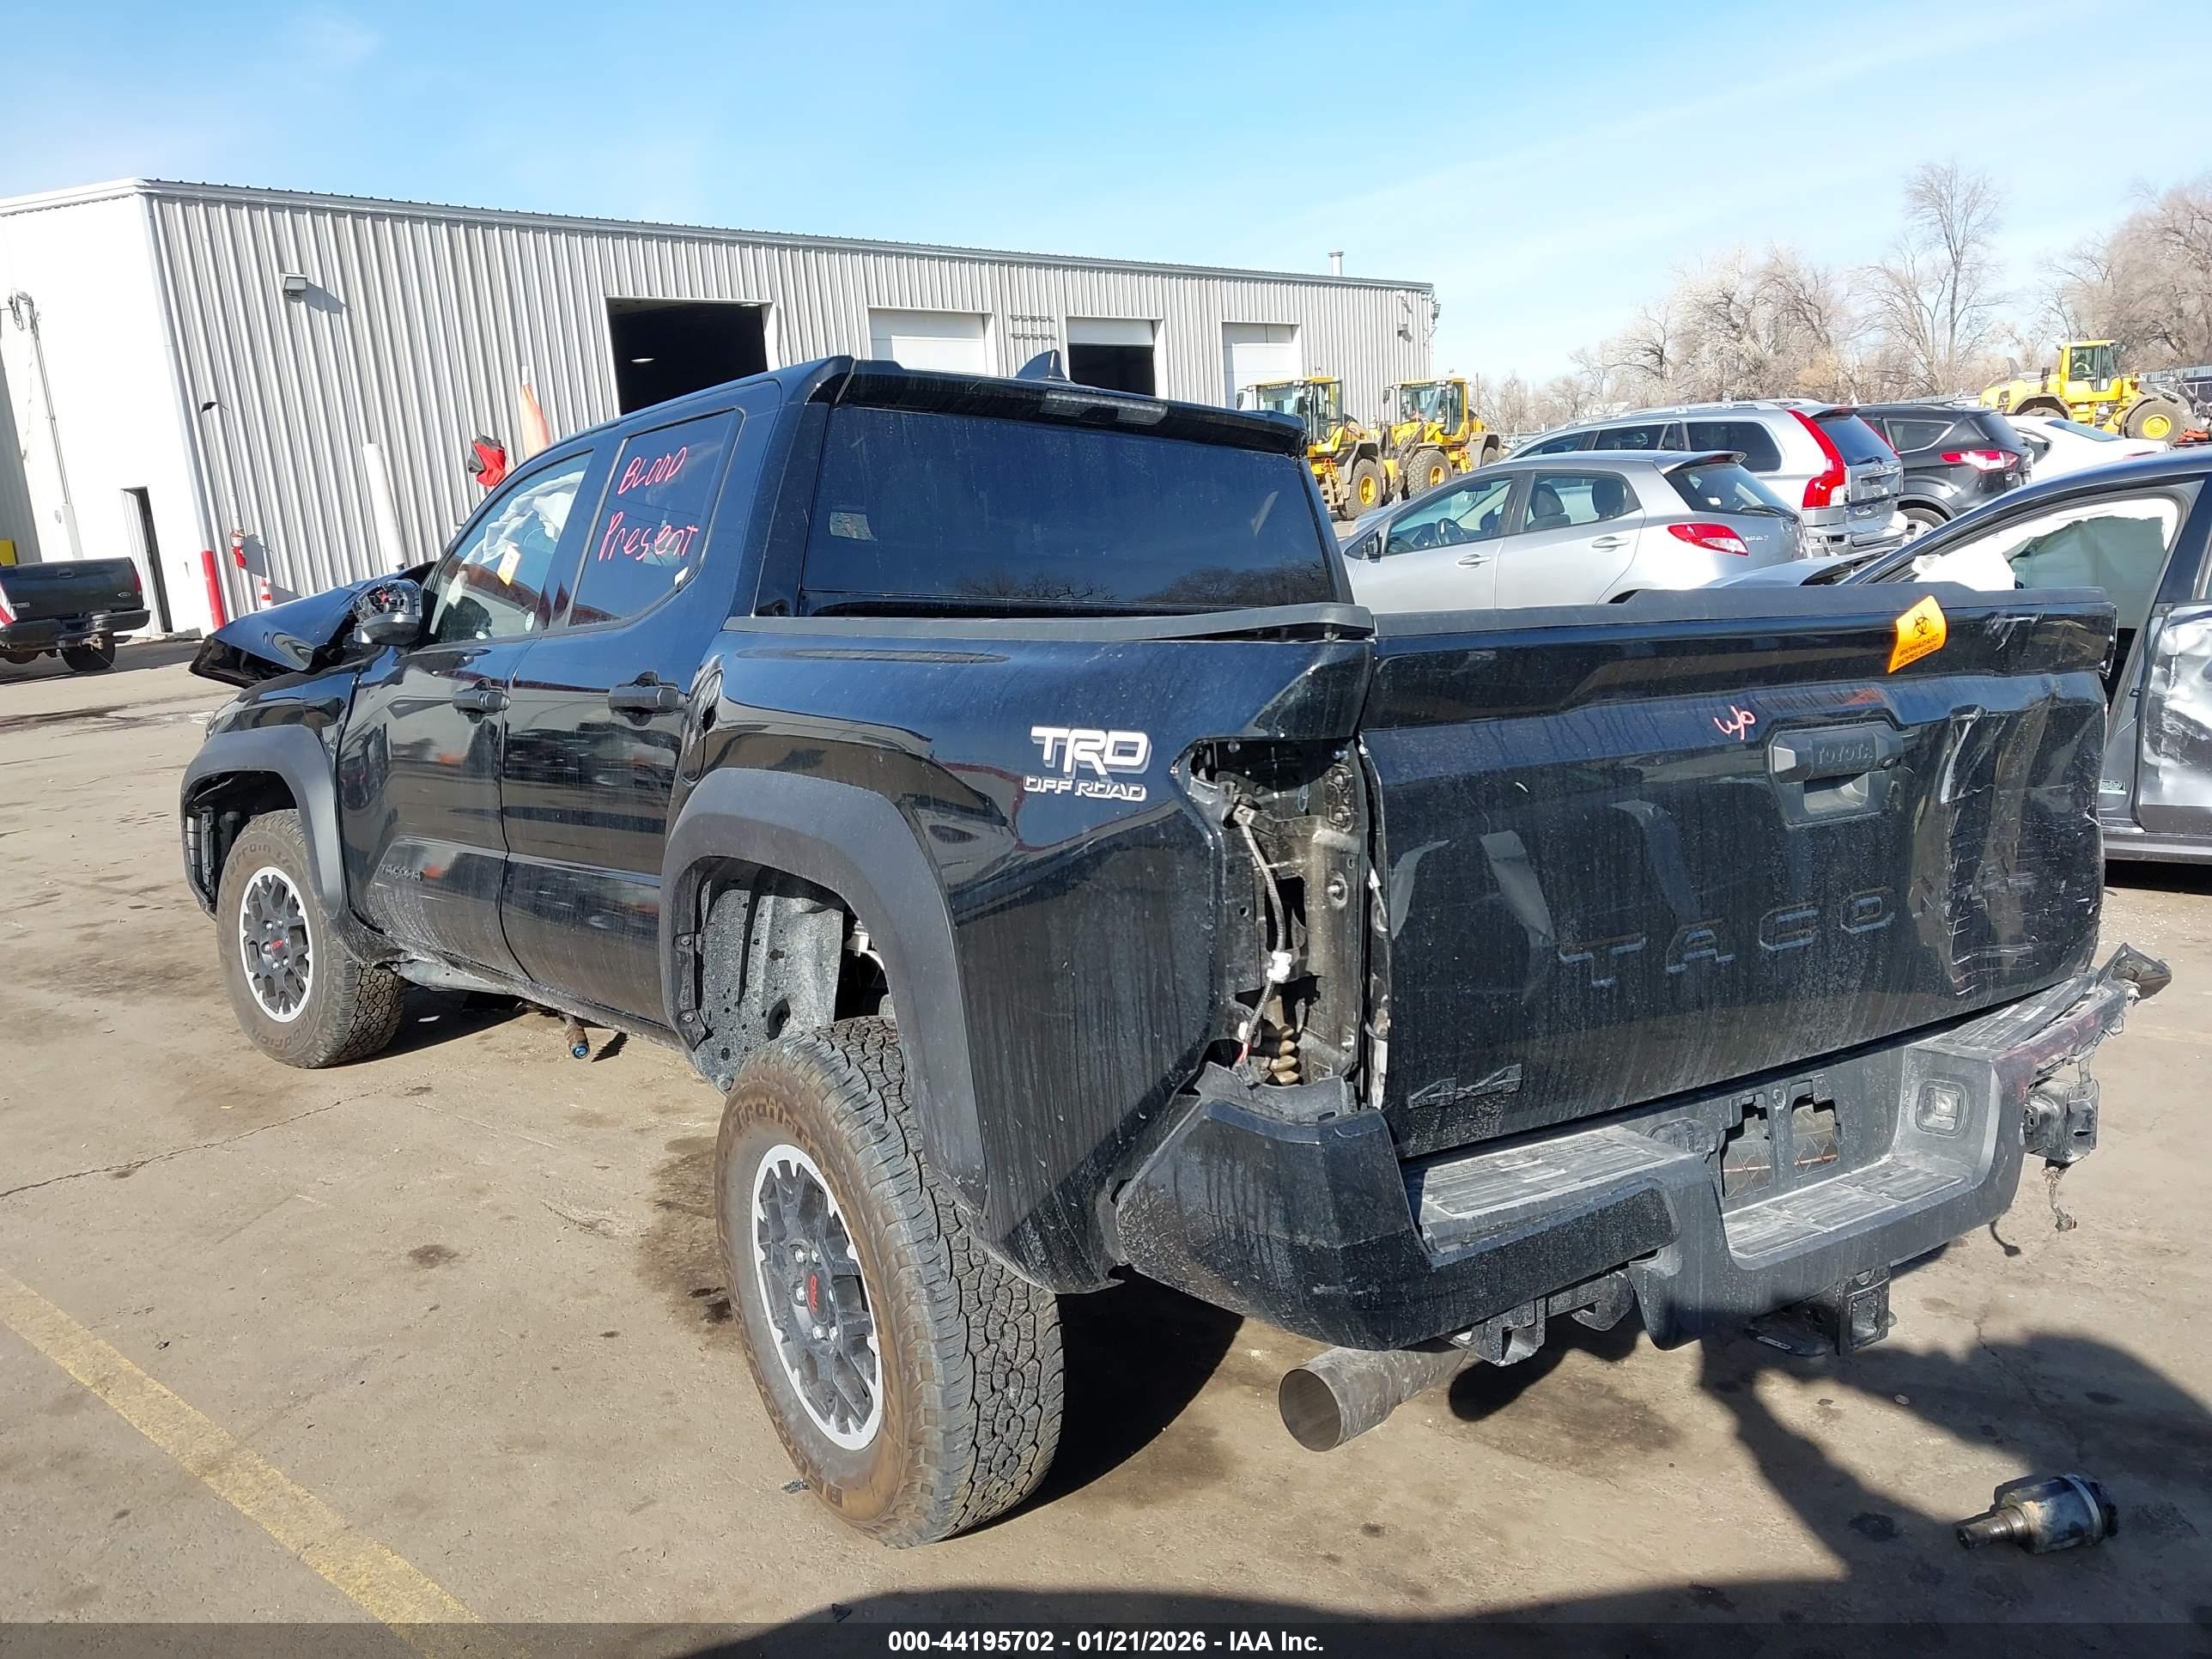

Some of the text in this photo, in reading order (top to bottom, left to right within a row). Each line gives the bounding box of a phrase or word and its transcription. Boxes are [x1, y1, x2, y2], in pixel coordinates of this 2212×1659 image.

[617, 447, 687, 495] BLOOD
[1030, 726, 1152, 780] TRD
[1818, 743, 1874, 764] TOYOTA
[1023, 775, 1147, 802] OFF ROAD
[1559, 876, 1941, 988] TACO
[1407, 1063, 1523, 1110] 4x4
